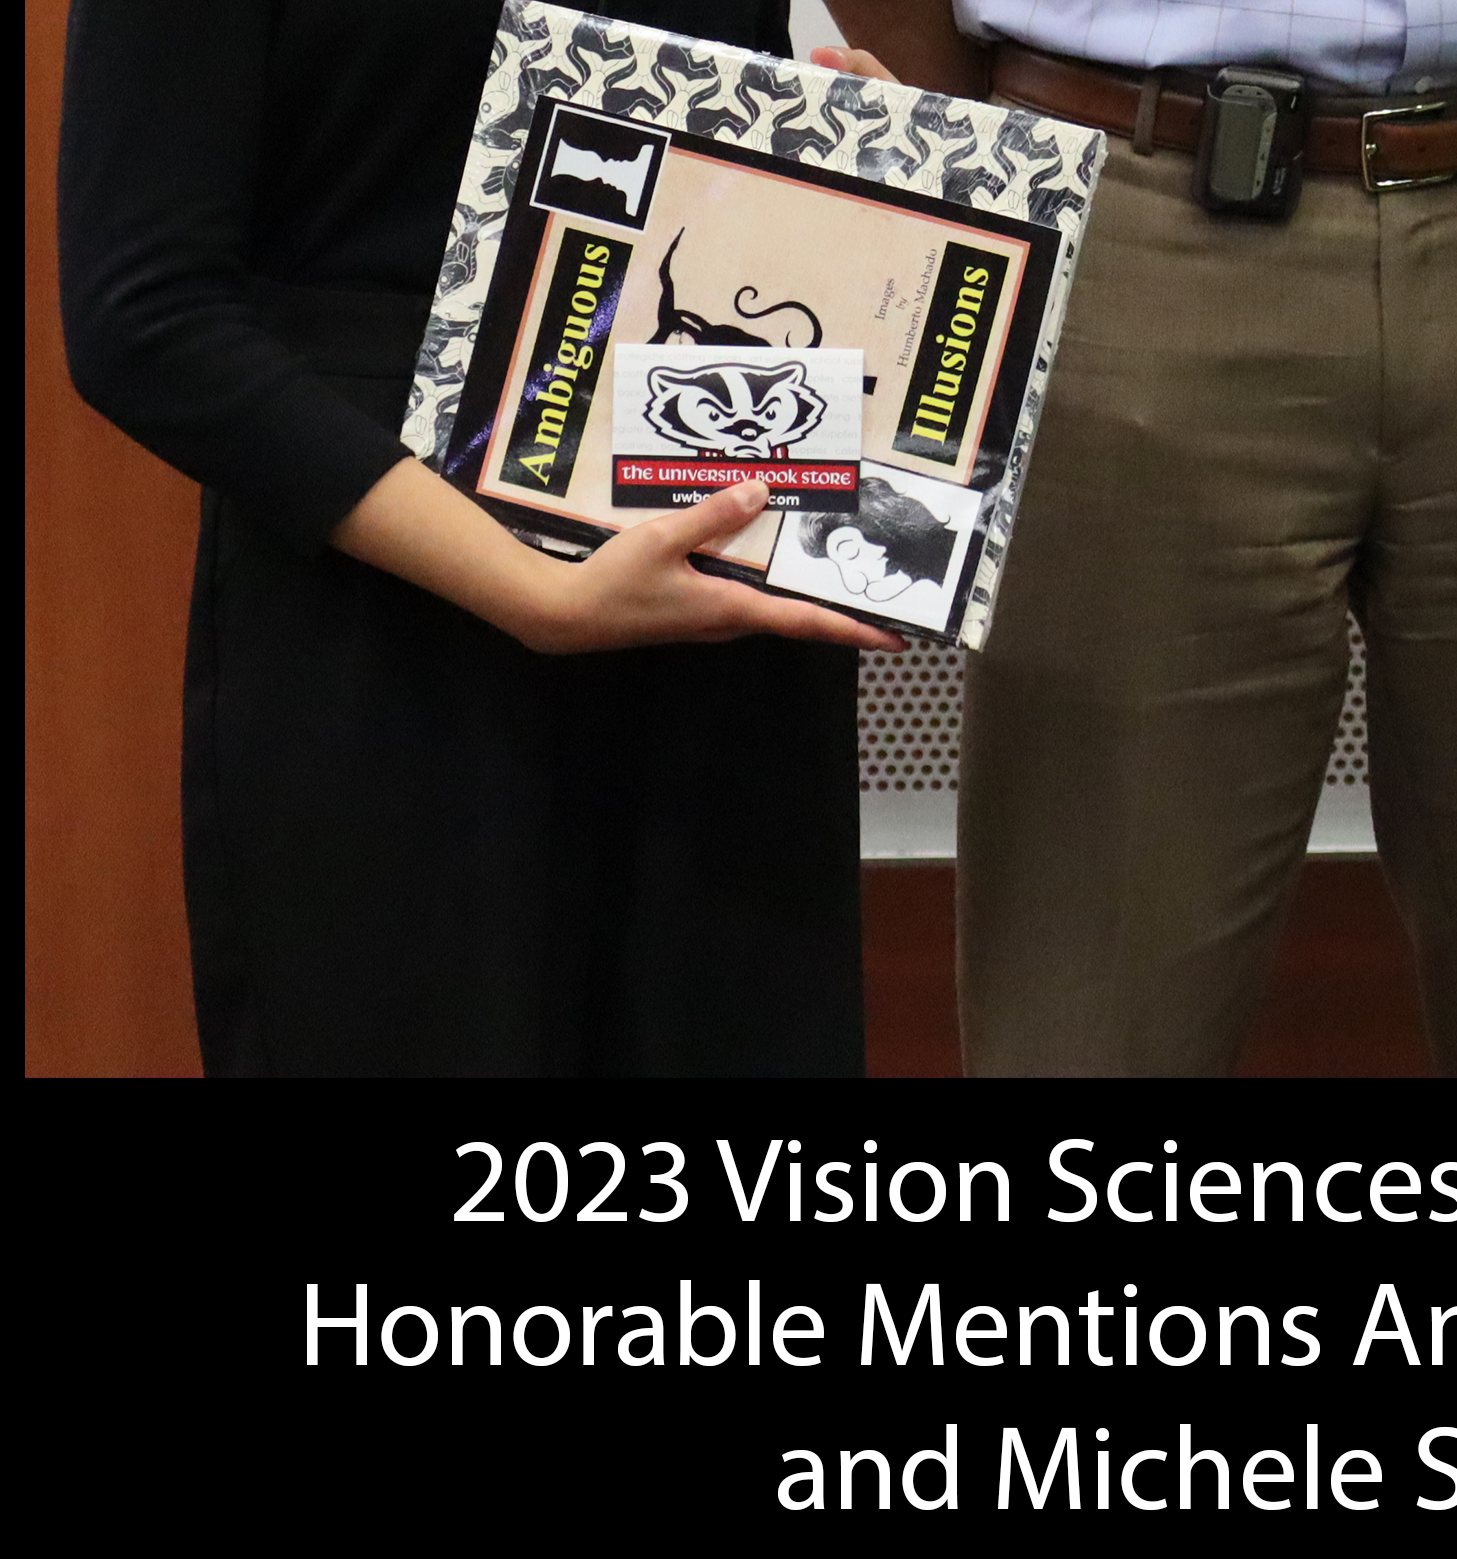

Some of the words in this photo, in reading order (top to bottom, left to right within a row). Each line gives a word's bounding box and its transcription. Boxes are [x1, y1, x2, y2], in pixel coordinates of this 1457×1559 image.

[874, 277, 896, 322] Images
[895, 296, 910, 311] by
[896, 305, 922, 369] Humberto
[919, 248, 938, 305] Machado
[910, 265, 990, 446] Illusions
[518, 242, 611, 487] Ambiguous
